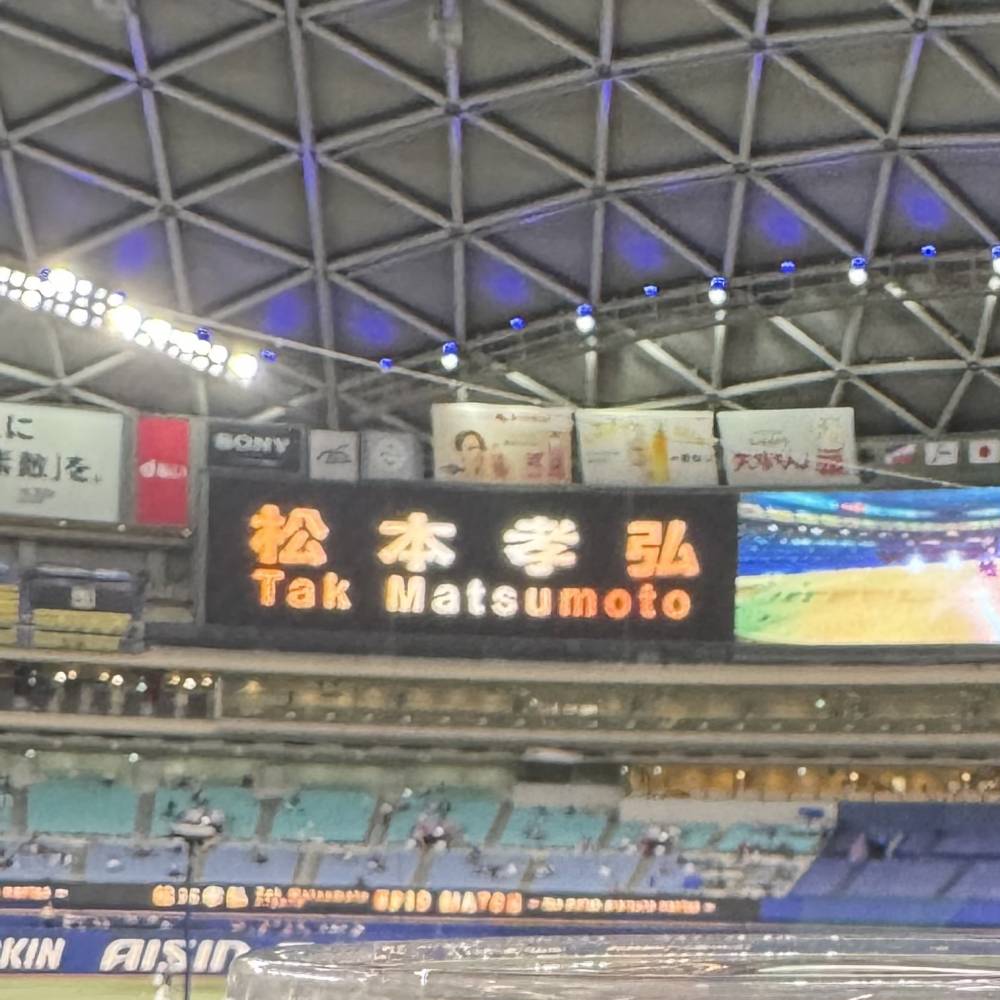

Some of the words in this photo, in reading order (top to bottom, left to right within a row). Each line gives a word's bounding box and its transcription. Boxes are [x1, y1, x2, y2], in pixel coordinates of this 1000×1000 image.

[215, 432, 290, 453] SONY
[252, 568, 352, 611] Tak
[384, 575, 692, 620] Matsumoto
[0, 936, 66, 970] KIN
